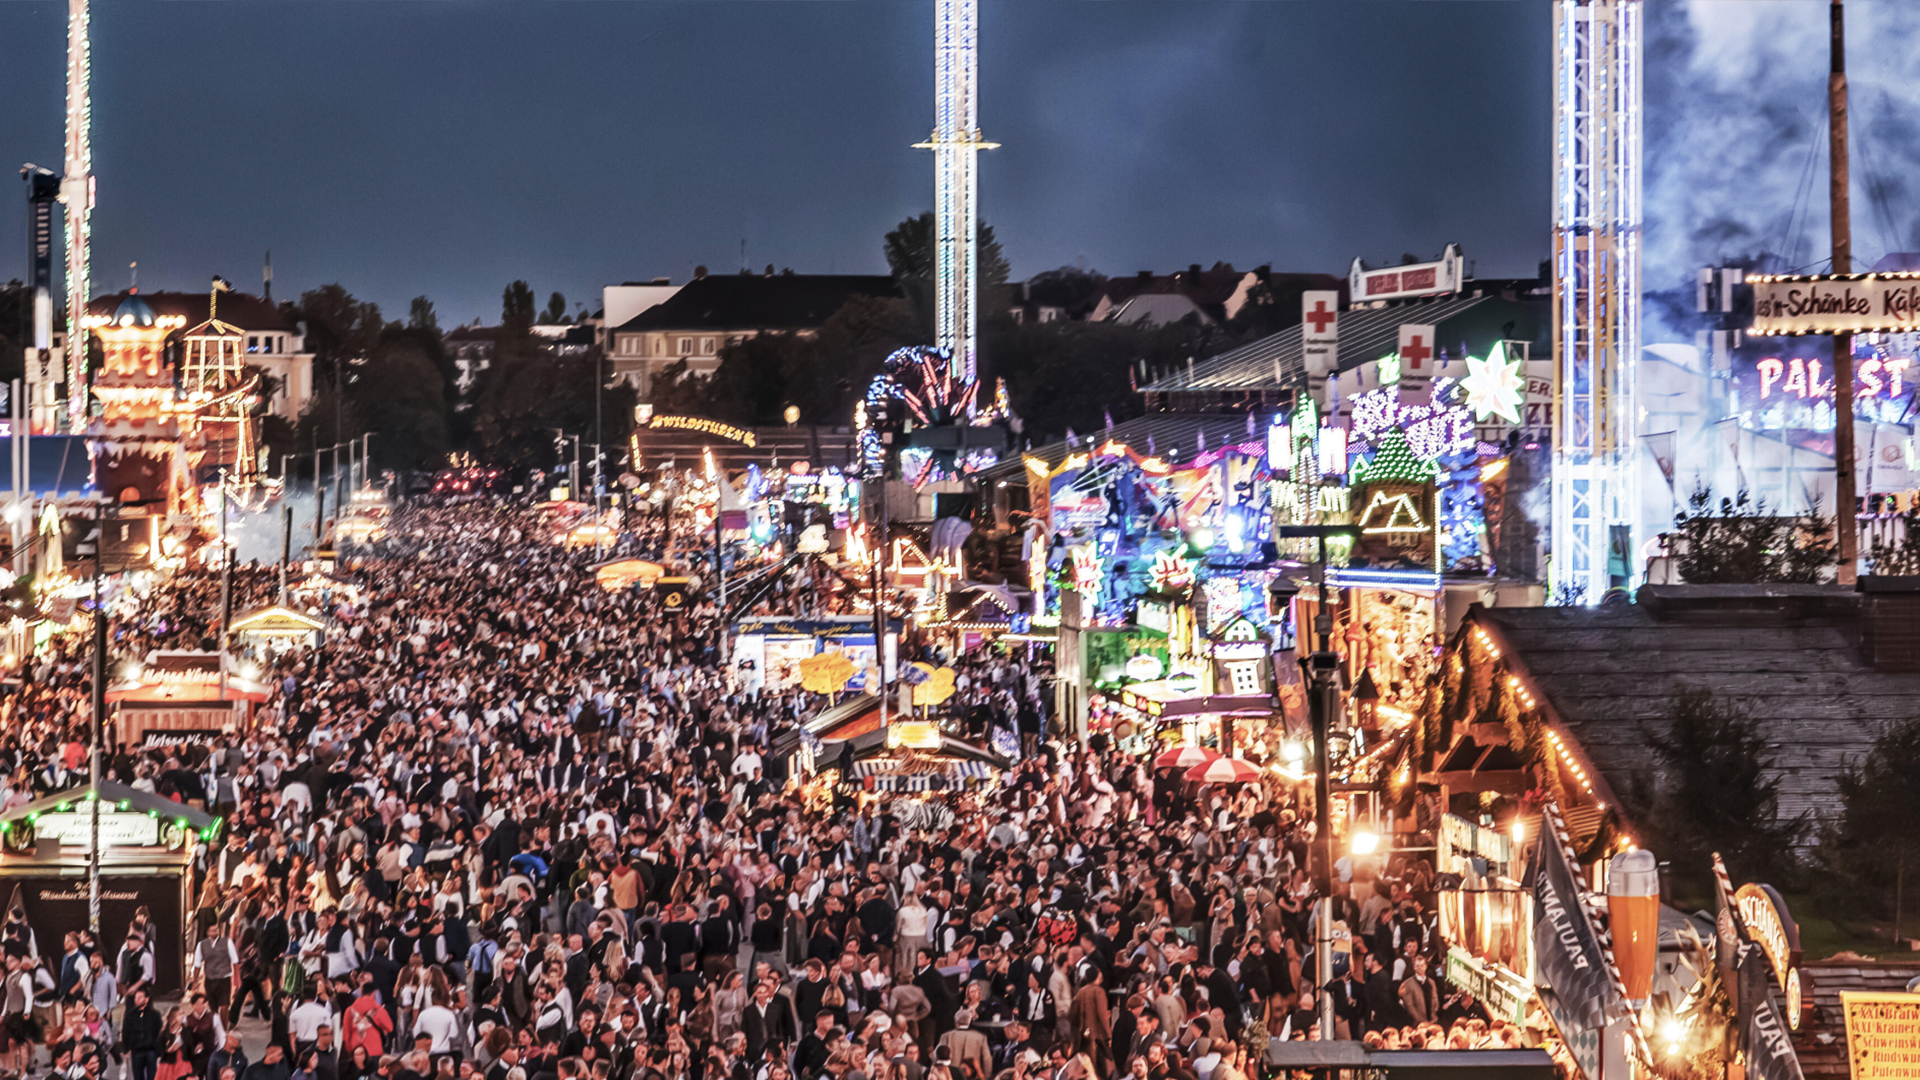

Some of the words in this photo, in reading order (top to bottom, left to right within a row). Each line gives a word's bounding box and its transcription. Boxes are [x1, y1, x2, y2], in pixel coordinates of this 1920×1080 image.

[1756, 358, 1911, 399] PALST
[1860, 1007, 1880, 1019] XXL
[1855, 1021, 1871, 1033] XXL
[1876, 1021, 1915, 1034] Krainer
